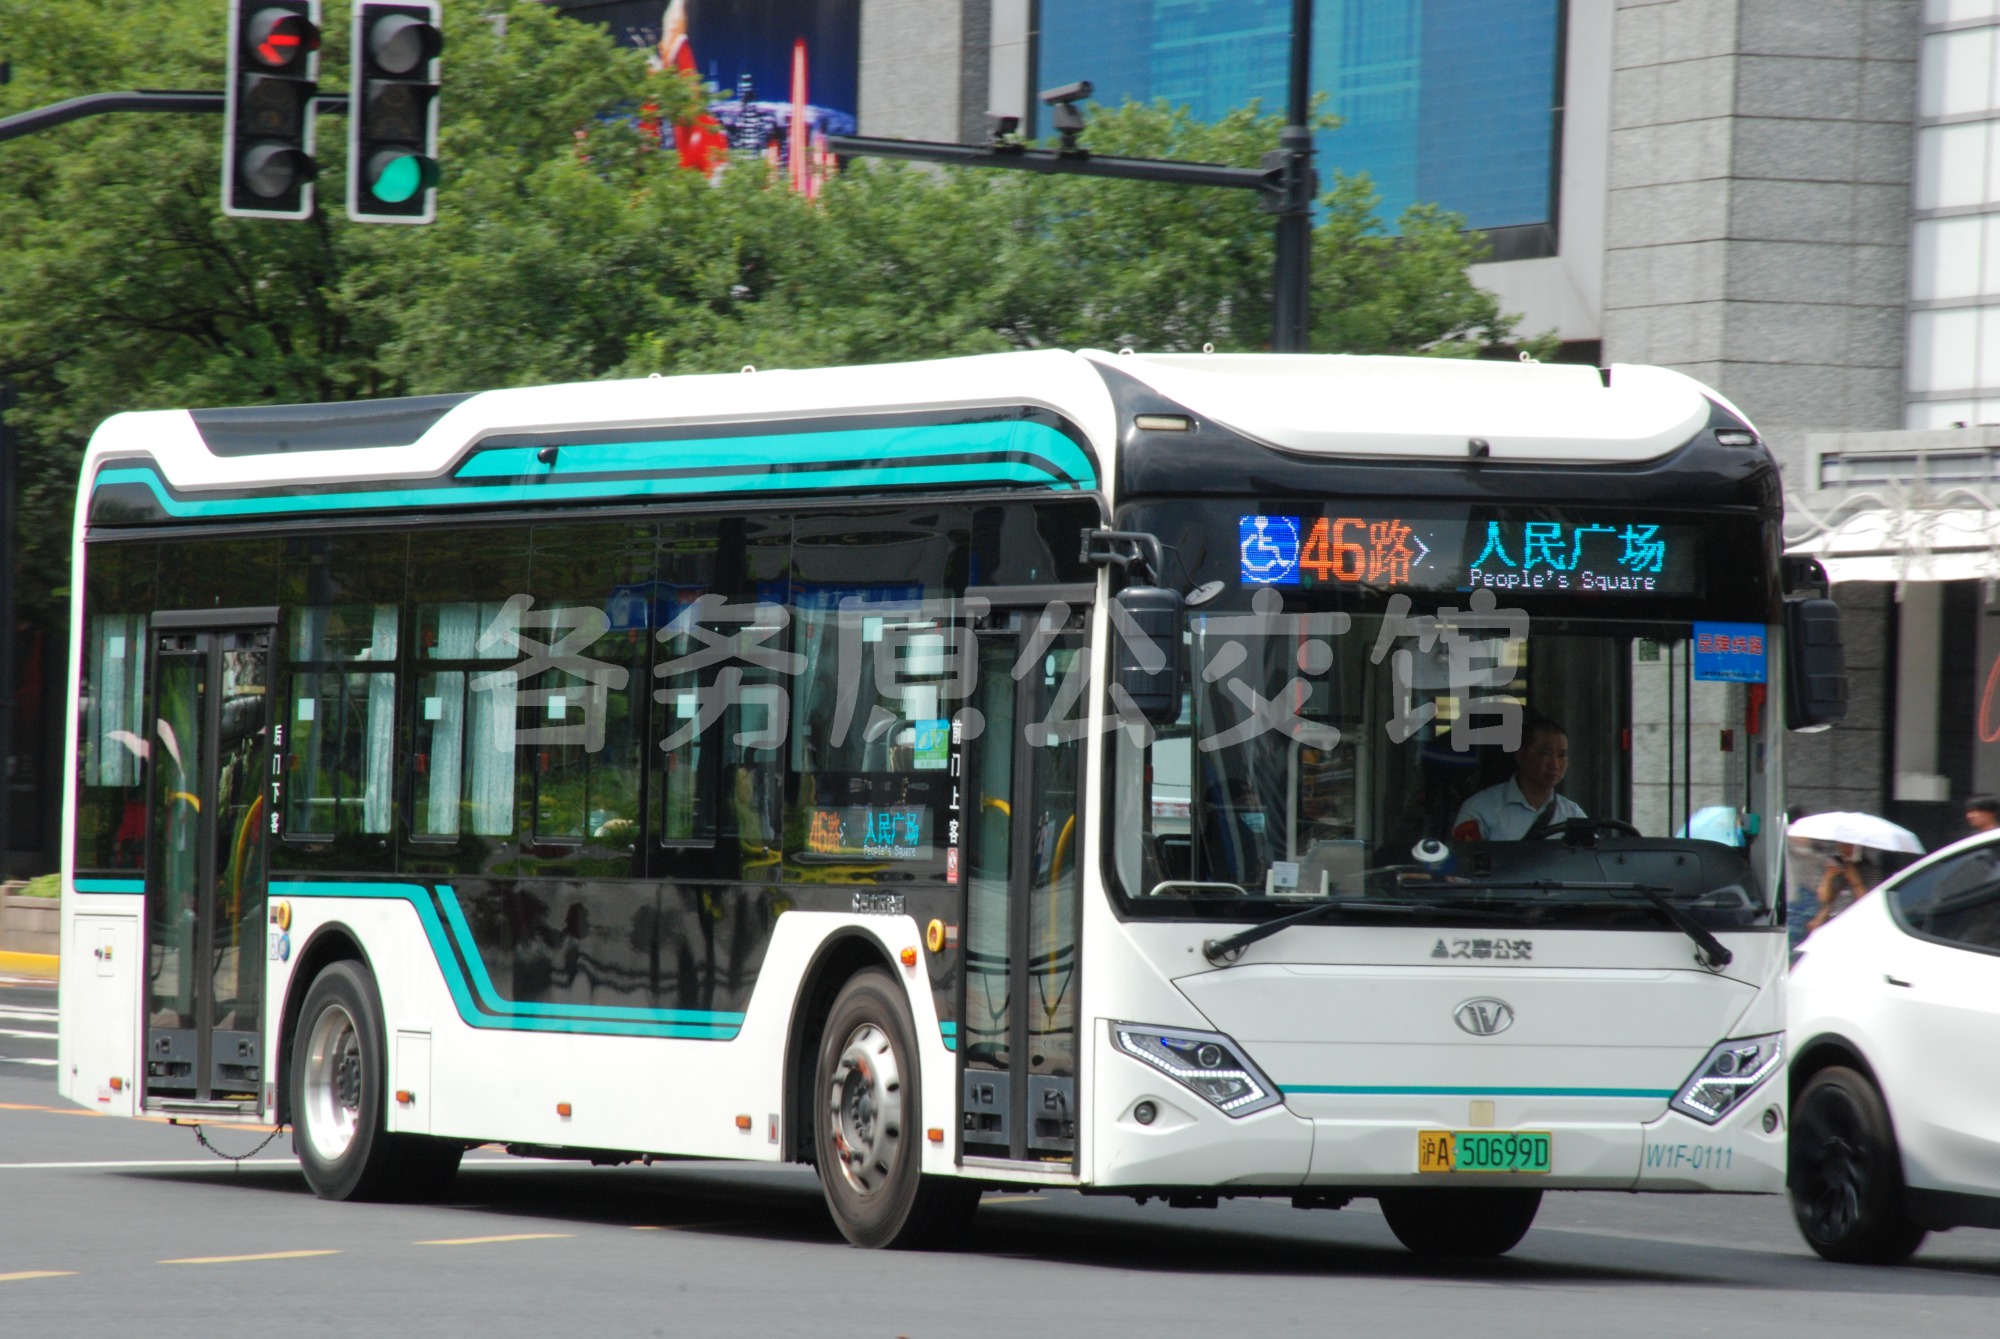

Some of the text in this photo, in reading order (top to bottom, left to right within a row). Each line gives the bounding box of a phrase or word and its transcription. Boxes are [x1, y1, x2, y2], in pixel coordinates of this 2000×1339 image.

[1300, 517, 1414, 584] 46路
[1470, 521, 1665, 572] 人民广场
[1470, 568, 1656, 590] People's Square
[270, 724, 283, 834] 后门下客
[948, 719, 962, 844] 前门上客
[864, 811, 919, 845] 人民广场
[894, 845, 916, 856] Square
[1462, 1138, 1548, 1167] 50699D
[1647, 1143, 1733, 1170] W1F-0111
